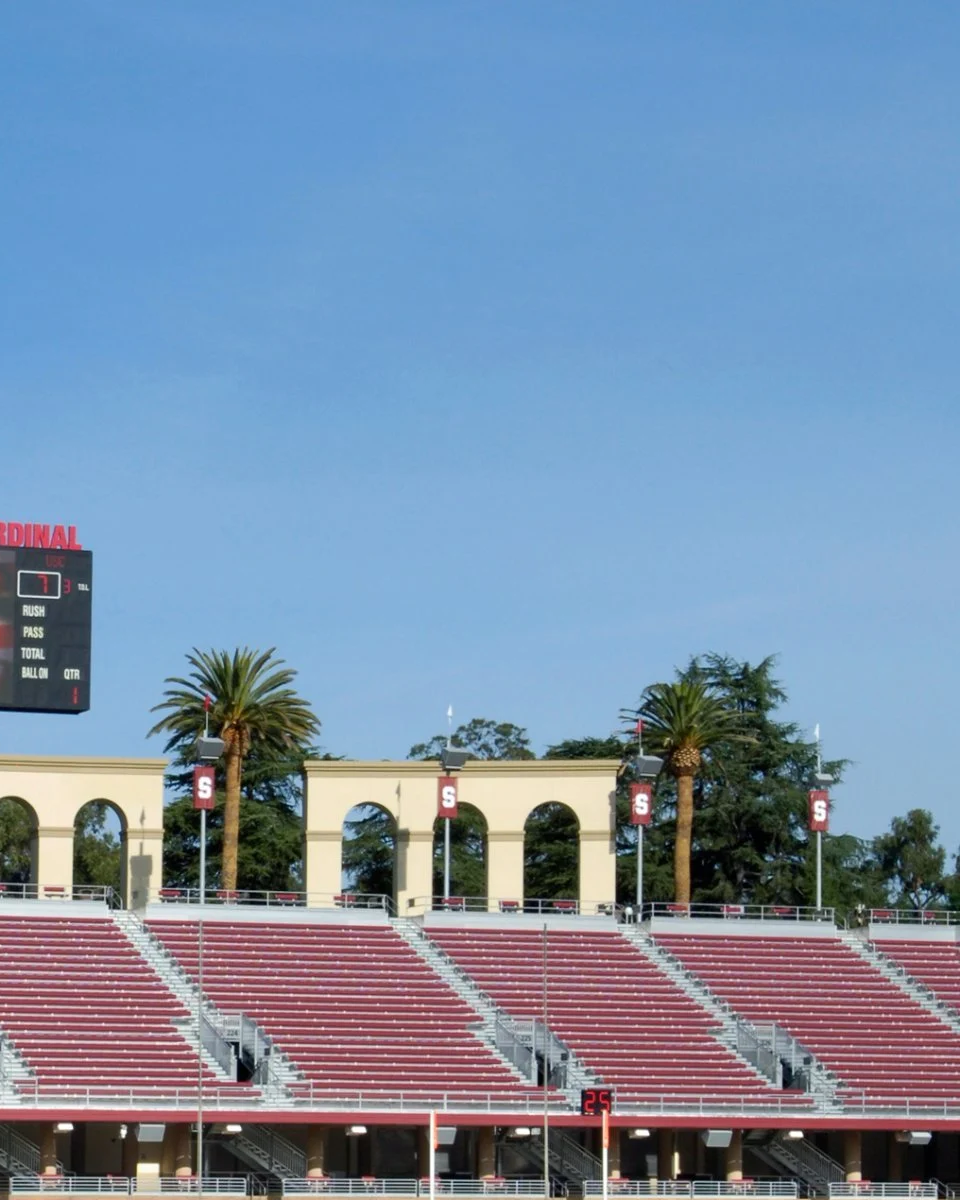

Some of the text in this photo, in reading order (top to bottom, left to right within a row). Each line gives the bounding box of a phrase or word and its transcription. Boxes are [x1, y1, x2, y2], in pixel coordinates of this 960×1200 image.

[37, 573, 49, 595] 7
[22, 604, 46, 618] RUSH
[23, 626, 45, 639] PASS
[21, 647, 46, 660] TOTAL
[21, 666, 49, 679] BALL ON
[63, 668, 80, 681] QTR
[197, 776, 213, 799] S
[441, 785, 456, 809] S
[635, 793, 649, 815] S
[813, 800, 827, 822] S
[584, 1091, 610, 1112] 25
